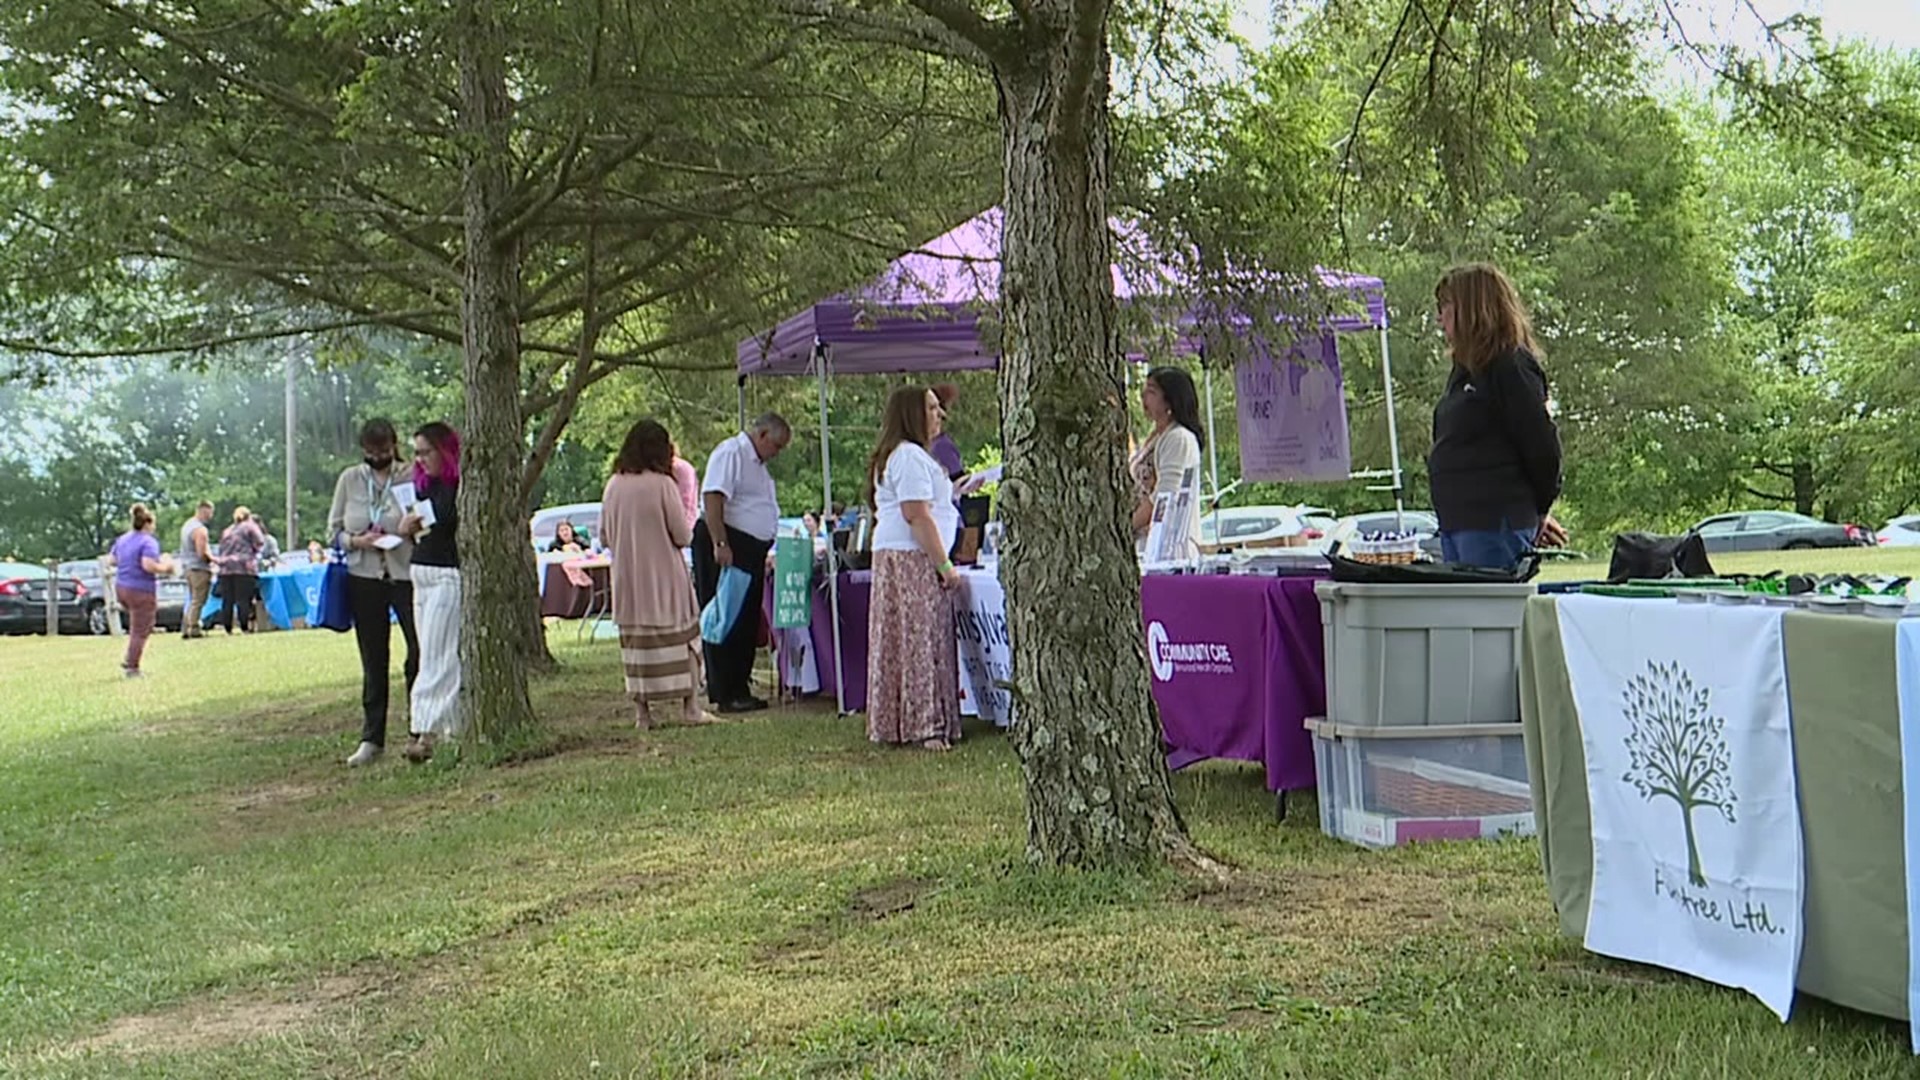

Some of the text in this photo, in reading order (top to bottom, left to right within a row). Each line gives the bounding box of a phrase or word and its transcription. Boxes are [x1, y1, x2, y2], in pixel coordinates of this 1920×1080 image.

[1161, 643, 1231, 662] COMMUNITY CARE
[1727, 899, 1785, 934] Ltd.
